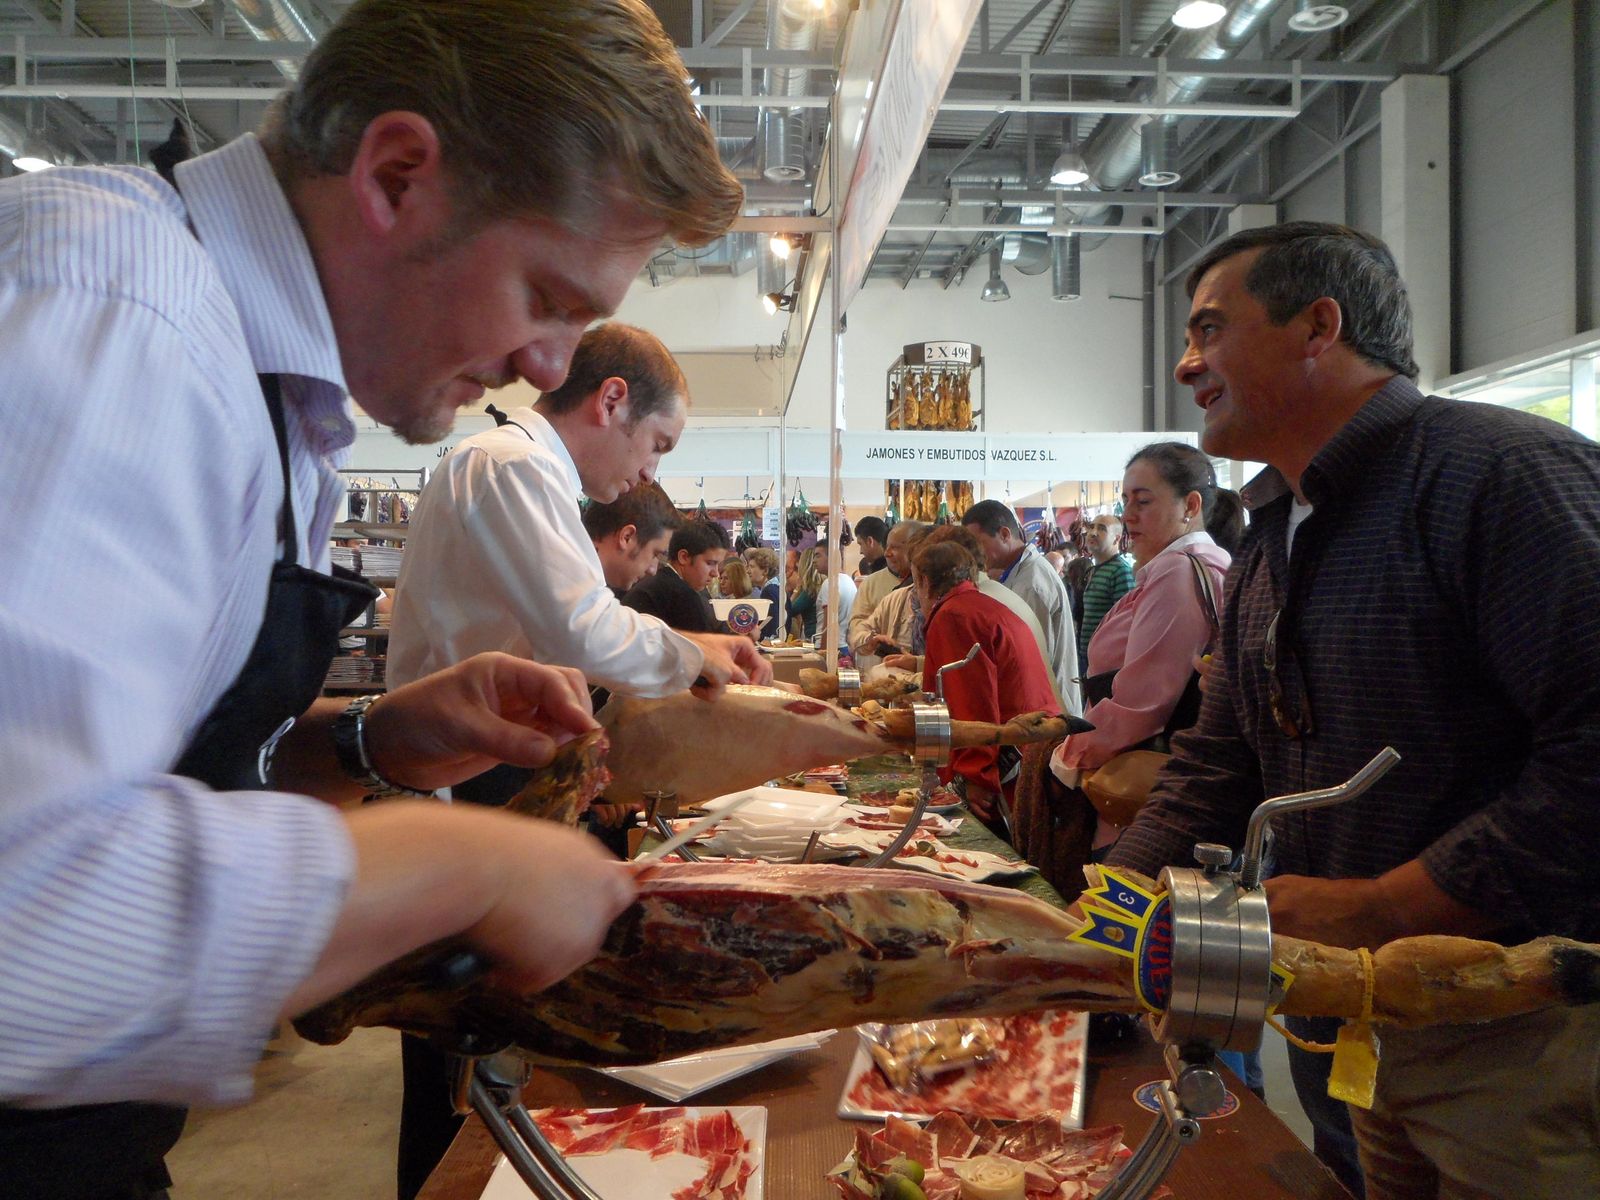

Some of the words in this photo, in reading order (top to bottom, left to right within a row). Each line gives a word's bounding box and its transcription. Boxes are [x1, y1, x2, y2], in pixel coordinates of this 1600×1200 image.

[926, 347, 933, 359] 2
[938, 346, 948, 358] X
[437, 446, 454, 458] JA
[866, 447, 915, 460] JAMONES
[918, 448, 924, 460] Y
[927, 448, 986, 461] EMBUTIDOS
[991, 449, 1037, 461] VAZQUEZ
[1039, 449, 1057, 461] S.L.
[1118, 891, 1135, 905] 3
